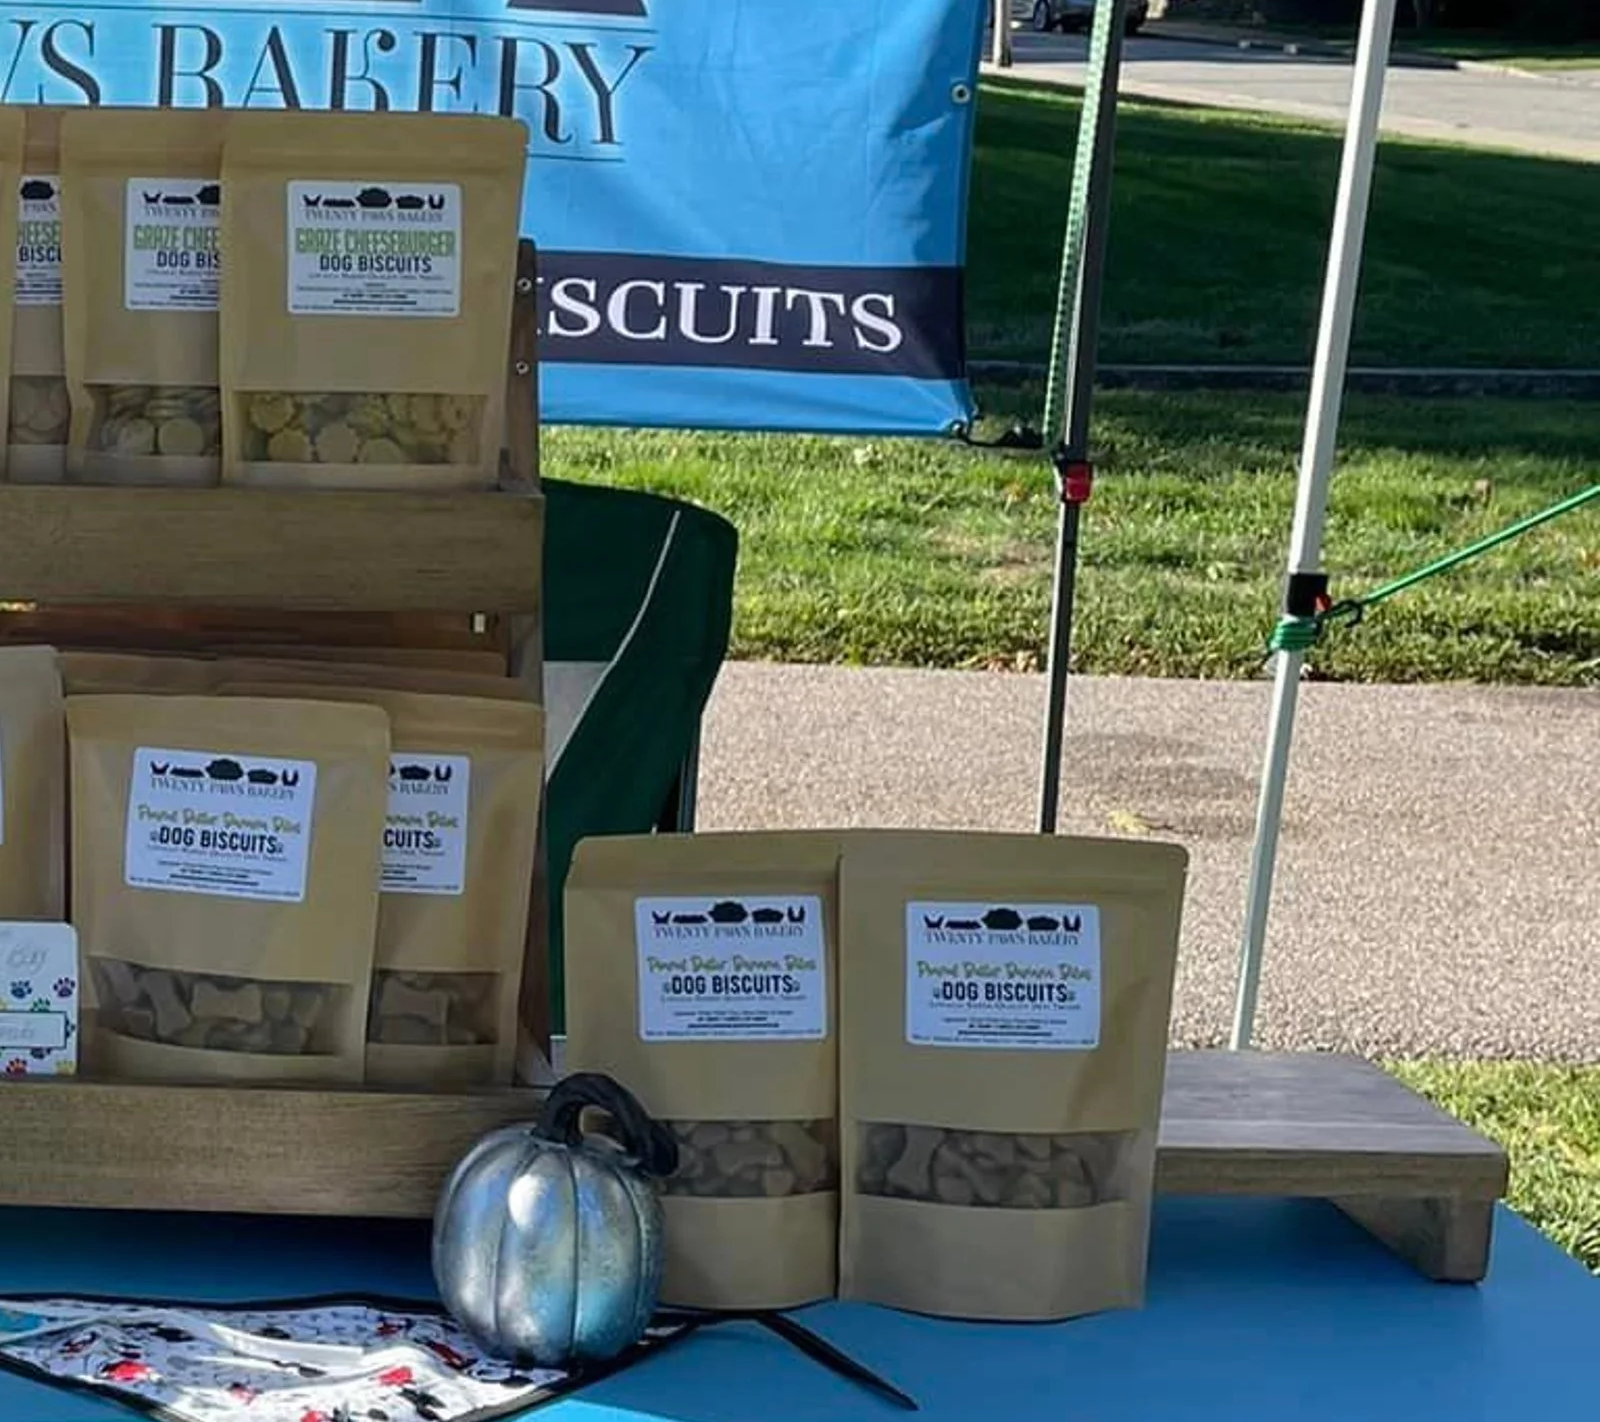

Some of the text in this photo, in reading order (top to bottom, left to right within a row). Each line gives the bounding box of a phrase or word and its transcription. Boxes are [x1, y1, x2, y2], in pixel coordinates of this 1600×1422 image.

[151, 23, 655, 145] BAKERY
[183, 226, 220, 250] CHEE
[157, 251, 221, 268] DOG BIS
[320, 255, 432, 273] DOG BISCUITS
[537, 277, 902, 352] SCUITS
[159, 827, 277, 853] DOG BISCUITS
[384, 829, 434, 848] CUITS
[672, 975, 794, 994] DOG BISCUITS
[942, 982, 1068, 1003] DOG BISCUITS
